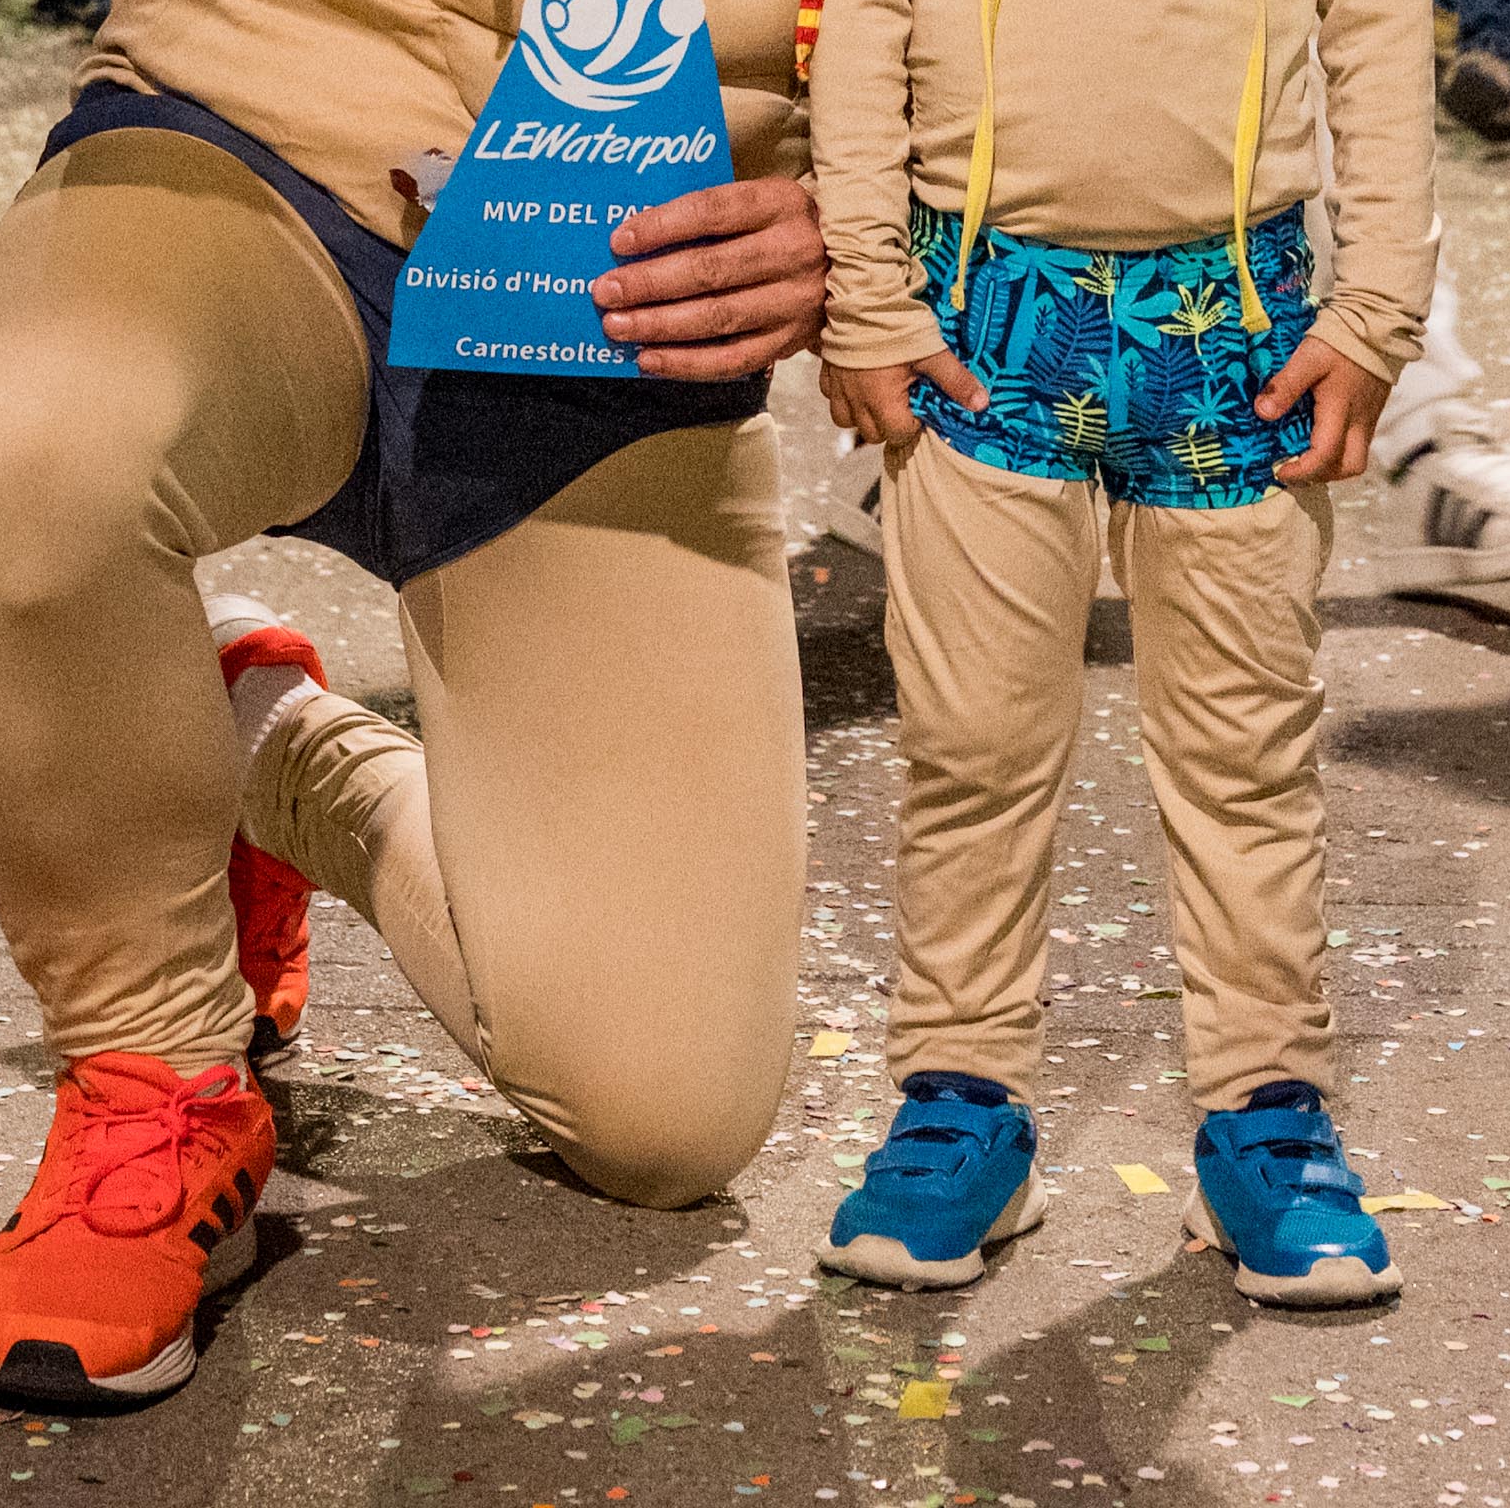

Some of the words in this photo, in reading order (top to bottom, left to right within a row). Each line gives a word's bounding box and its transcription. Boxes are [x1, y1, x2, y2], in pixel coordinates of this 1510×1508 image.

[473, 119, 717, 175] LEWaterpolo
[483, 200, 542, 223] MVP
[548, 202, 598, 224] DEL
[606, 204, 653, 225] PA
[406, 266, 498, 292] Divisió
[455, 336, 625, 365] Carnestoltes
